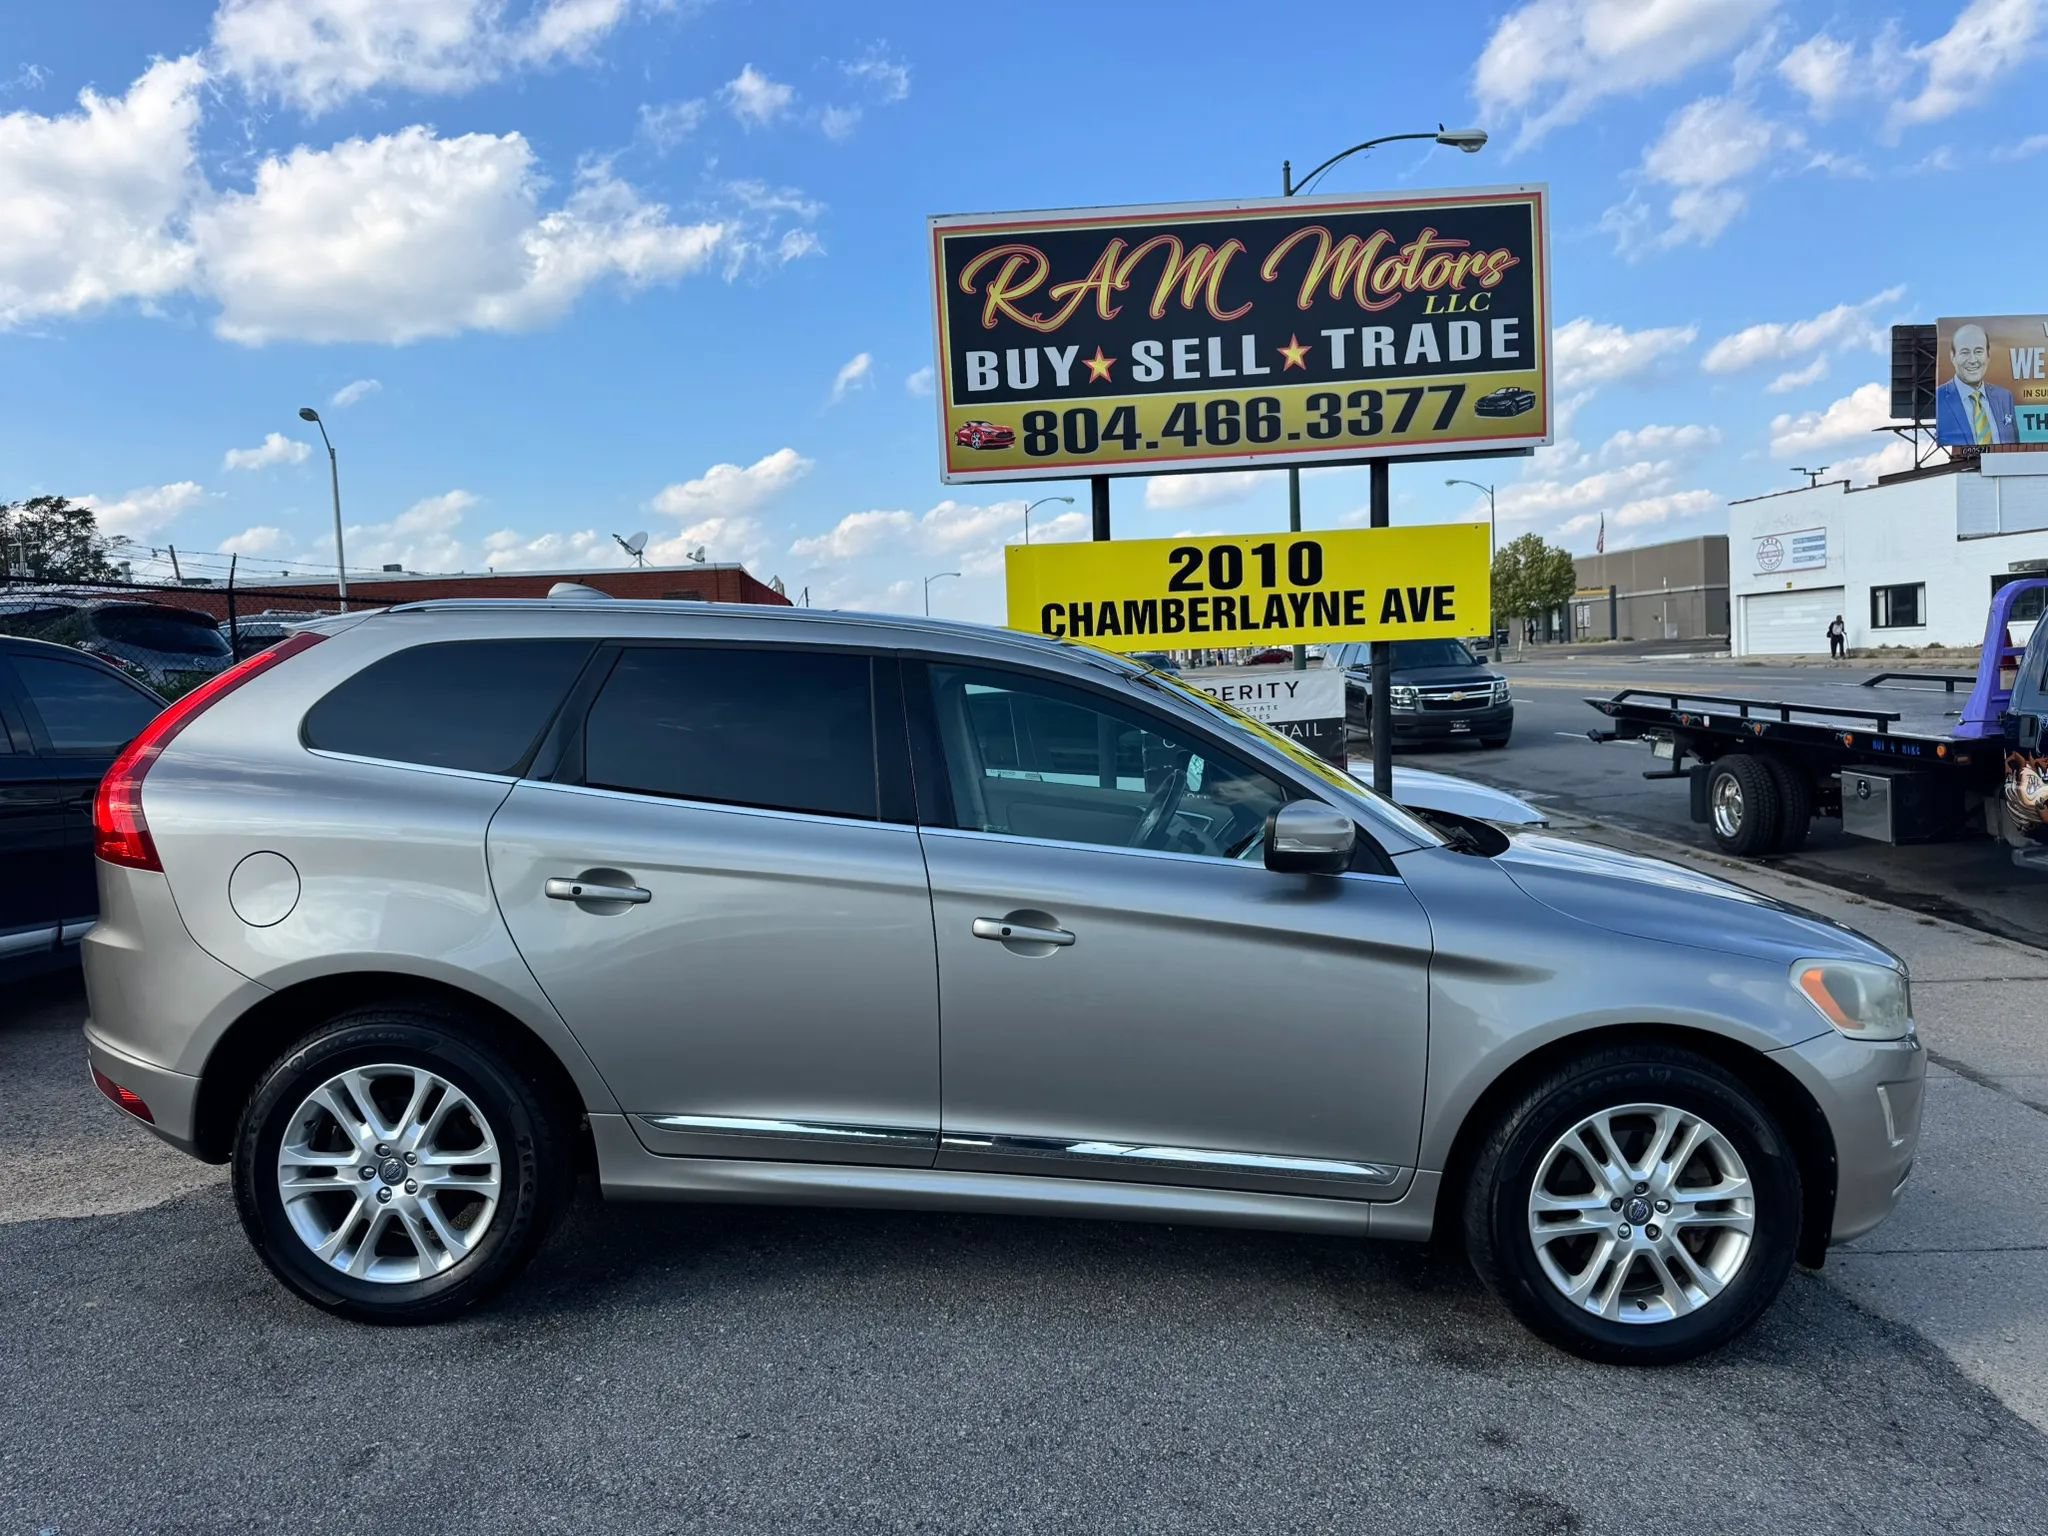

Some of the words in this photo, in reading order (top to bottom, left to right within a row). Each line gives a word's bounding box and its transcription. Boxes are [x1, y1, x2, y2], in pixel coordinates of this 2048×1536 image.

[1260, 225, 1520, 313] Motors
[1422, 291, 1492, 316] LLC
[965, 344, 1080, 392] BUY
[1131, 333, 1271, 384] SELL
[1320, 316, 1521, 370] TRADE
[2009, 347, 2046, 380] WE
[2023, 389, 2033, 398] IN
[2035, 388, 2048, 398] SU
[1021, 384, 1467, 458] 804.466.3377
[1167, 540, 1323, 593] 2010
[1041, 589, 1366, 638] CHAMBERLAYNE
[1379, 584, 1456, 624] AVE
